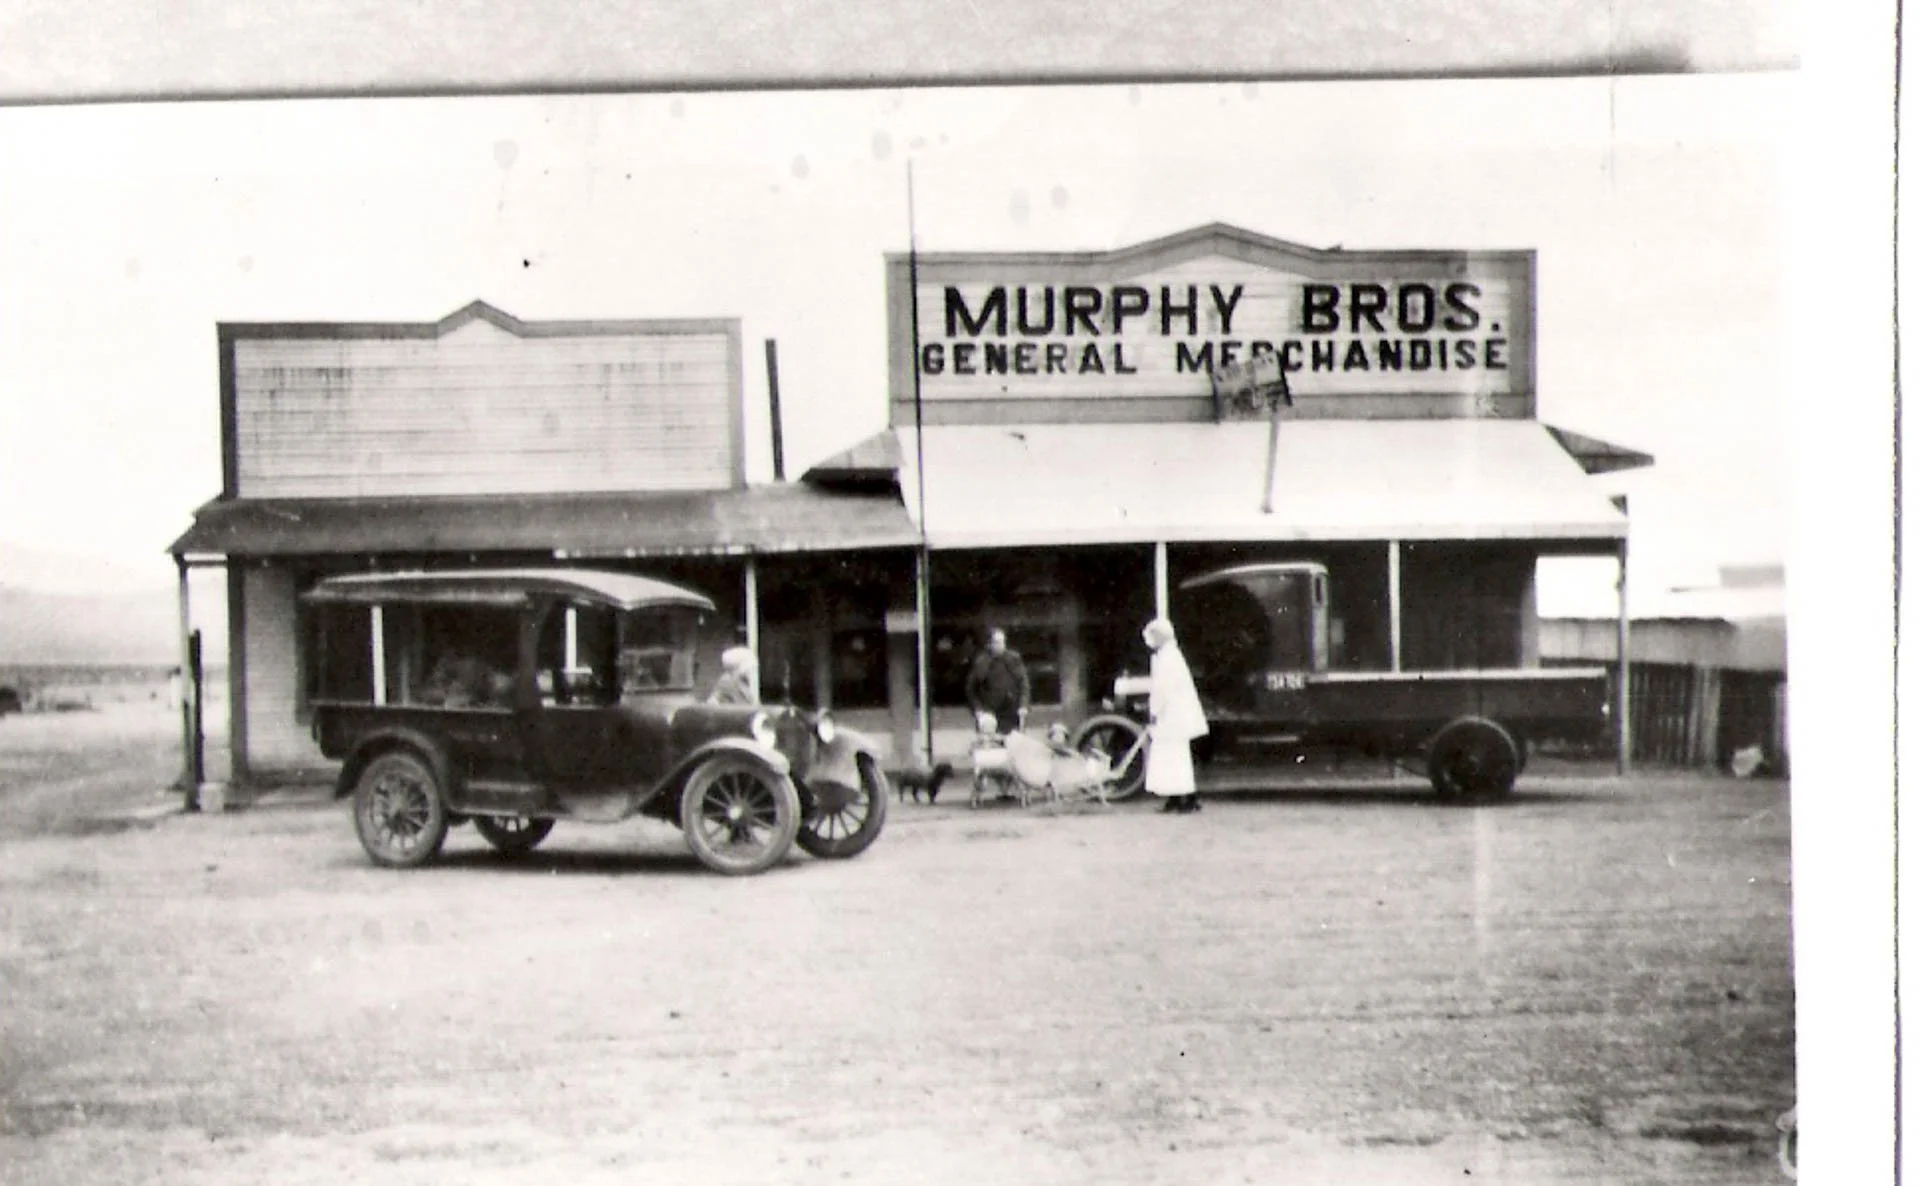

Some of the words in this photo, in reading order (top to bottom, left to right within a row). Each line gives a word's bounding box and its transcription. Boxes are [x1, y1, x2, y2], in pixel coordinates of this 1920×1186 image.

[944, 285, 1243, 337] MURPHY
[1302, 282, 1501, 335] BROS.
[921, 342, 1137, 375] GENERAL
